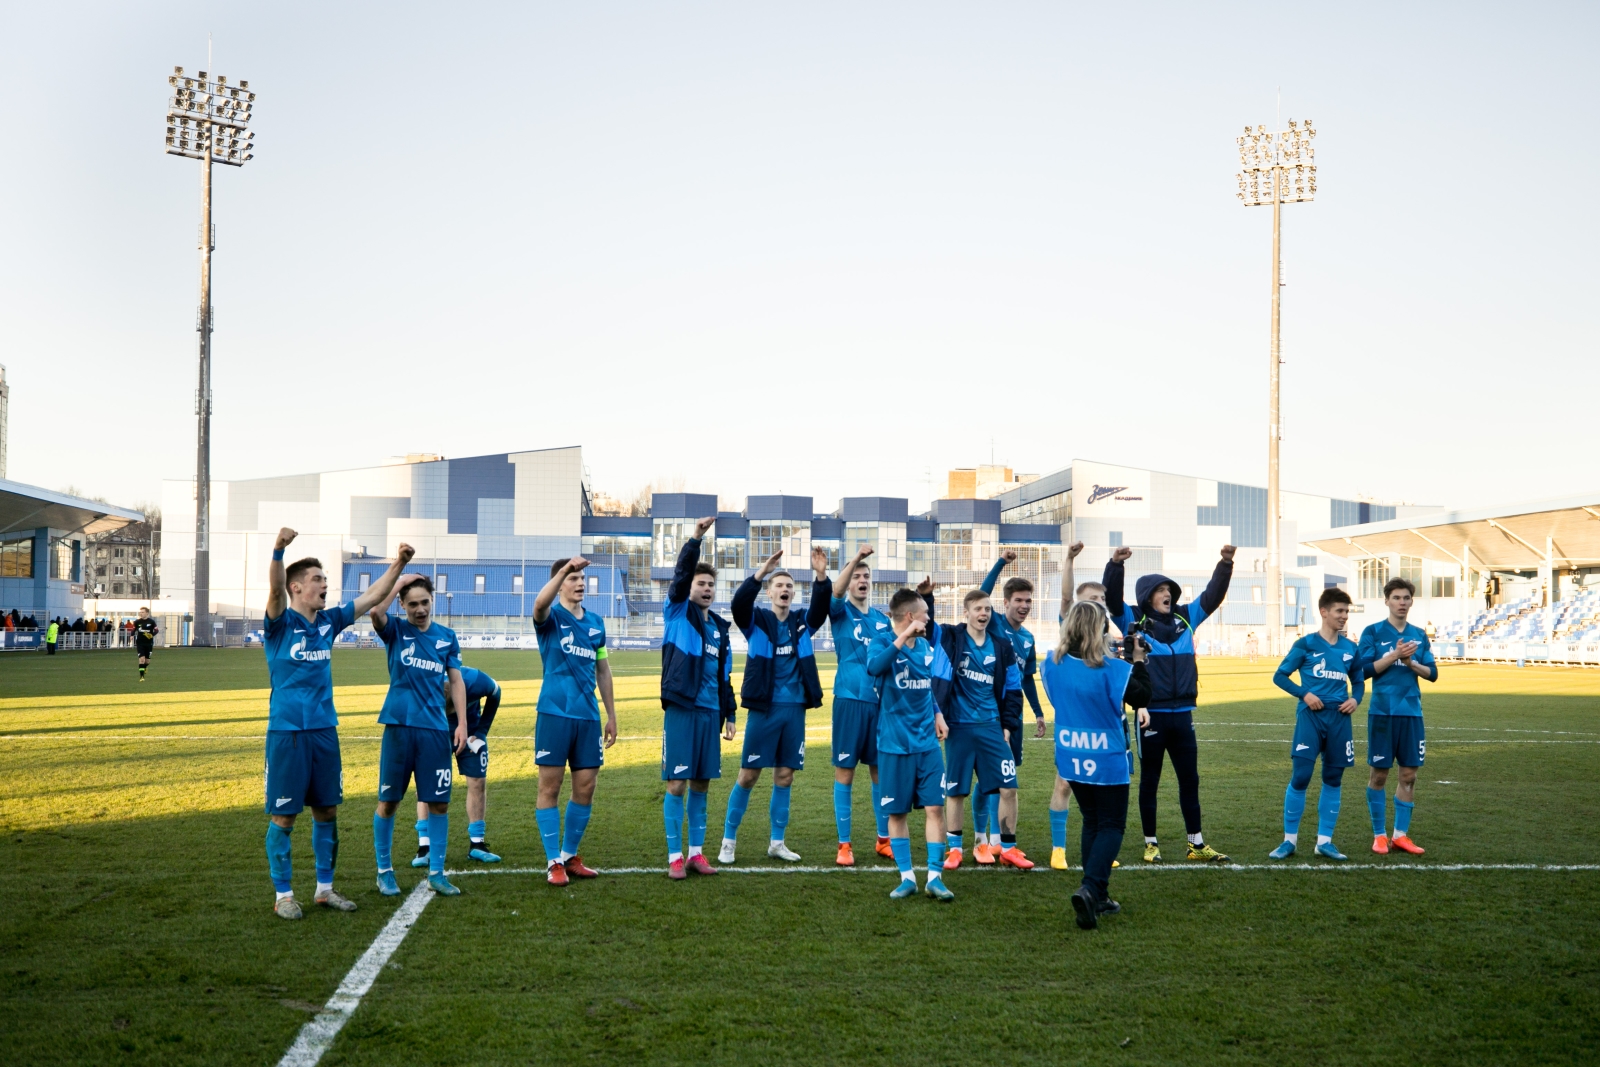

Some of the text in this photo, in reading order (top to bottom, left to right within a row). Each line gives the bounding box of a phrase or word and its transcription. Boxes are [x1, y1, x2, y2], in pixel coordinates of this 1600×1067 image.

[1059, 729, 1109, 750] СМИ
[1001, 759, 1016, 776] 68
[1071, 758, 1097, 777] 19
[436, 768, 452, 788] 79
